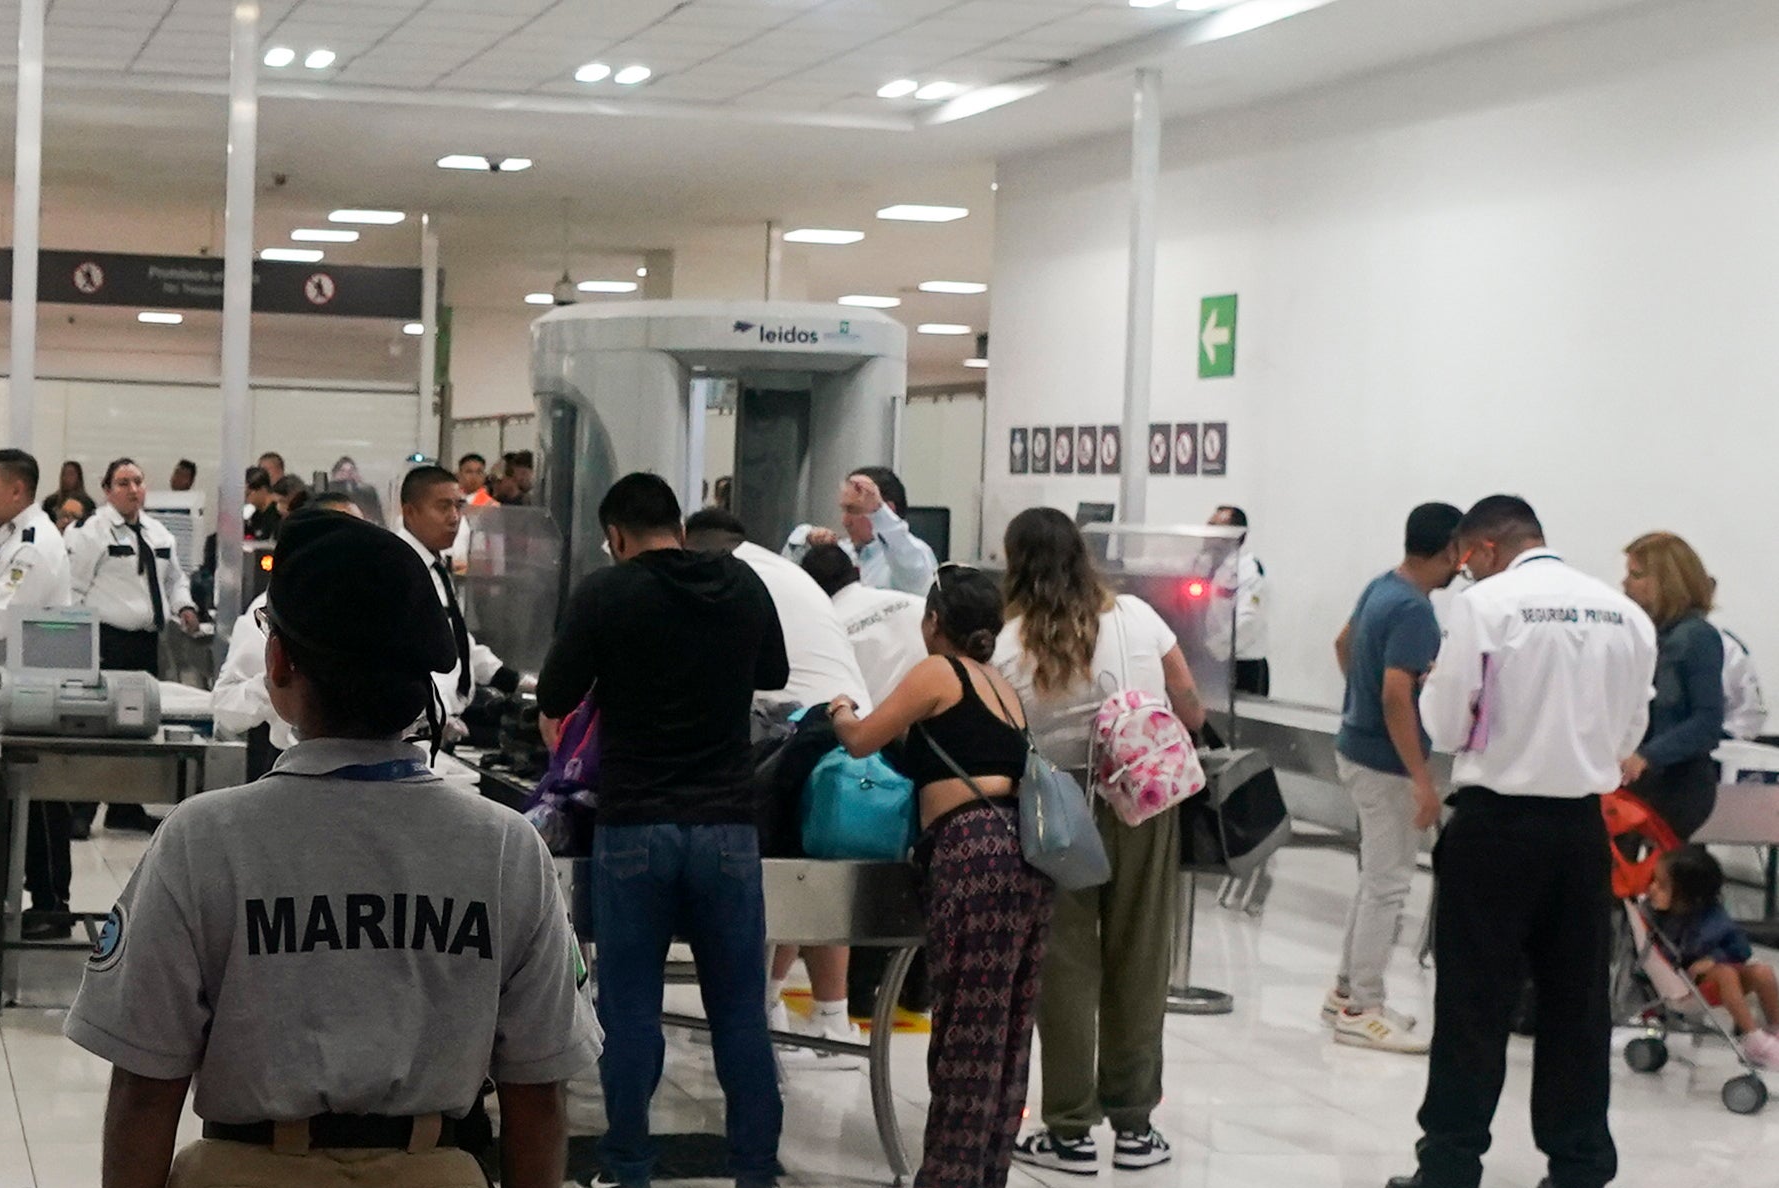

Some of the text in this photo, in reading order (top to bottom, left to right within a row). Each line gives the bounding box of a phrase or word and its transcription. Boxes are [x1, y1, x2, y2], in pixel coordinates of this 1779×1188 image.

[759, 324, 819, 344] leidos
[1521, 607, 1624, 624] SEGURIDAD PRIVADA
[246, 892, 494, 960] MARINA
